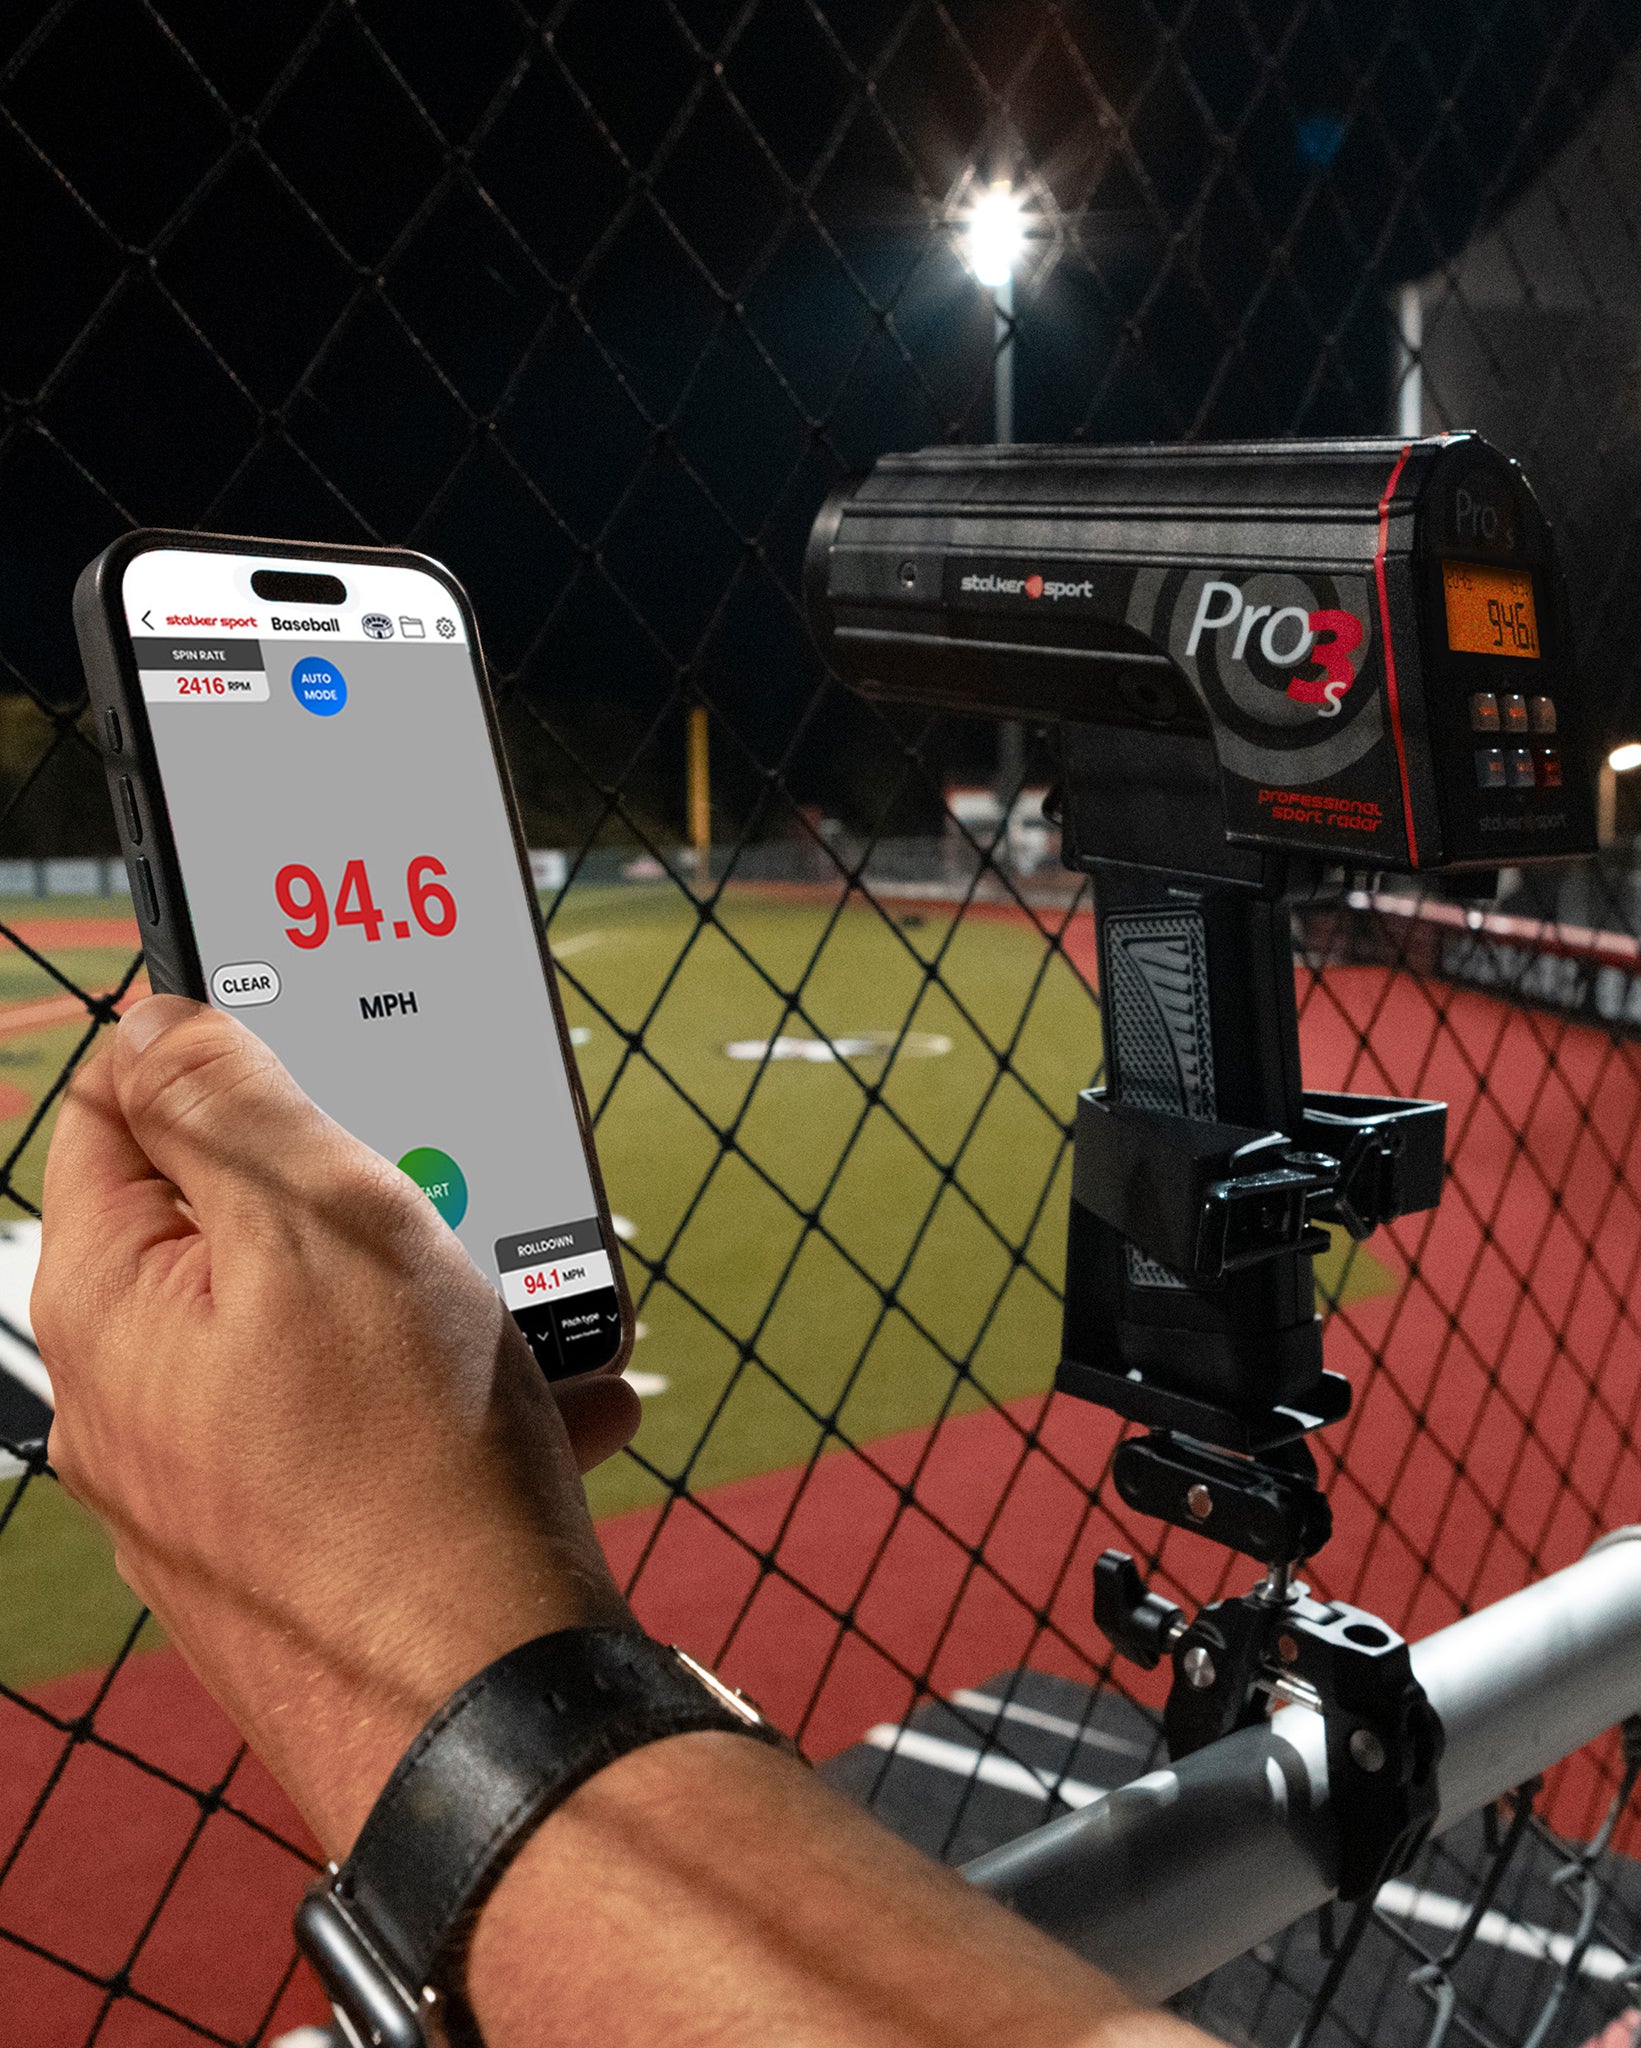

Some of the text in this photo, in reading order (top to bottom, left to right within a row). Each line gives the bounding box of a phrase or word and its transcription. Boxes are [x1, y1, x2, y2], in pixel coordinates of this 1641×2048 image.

[960, 575, 1093, 601] stalker sport
[165, 616, 340, 632] stalker sport Baseball
[172, 650, 226, 661] SPIN RATE
[177, 677, 251, 695] 2416 RPM
[301, 673, 332, 685] AUTO
[304, 689, 338, 701] MODE
[1258, 789, 1382, 816] professional
[1272, 806, 1382, 831] sport radar
[275, 855, 457, 950] 94.6
[222, 976, 271, 994] CLEAR
[359, 991, 418, 1020] MPH
[517, 1235, 574, 1257] ROLLDOWN
[524, 1267, 586, 1294] 94.1 MPH
